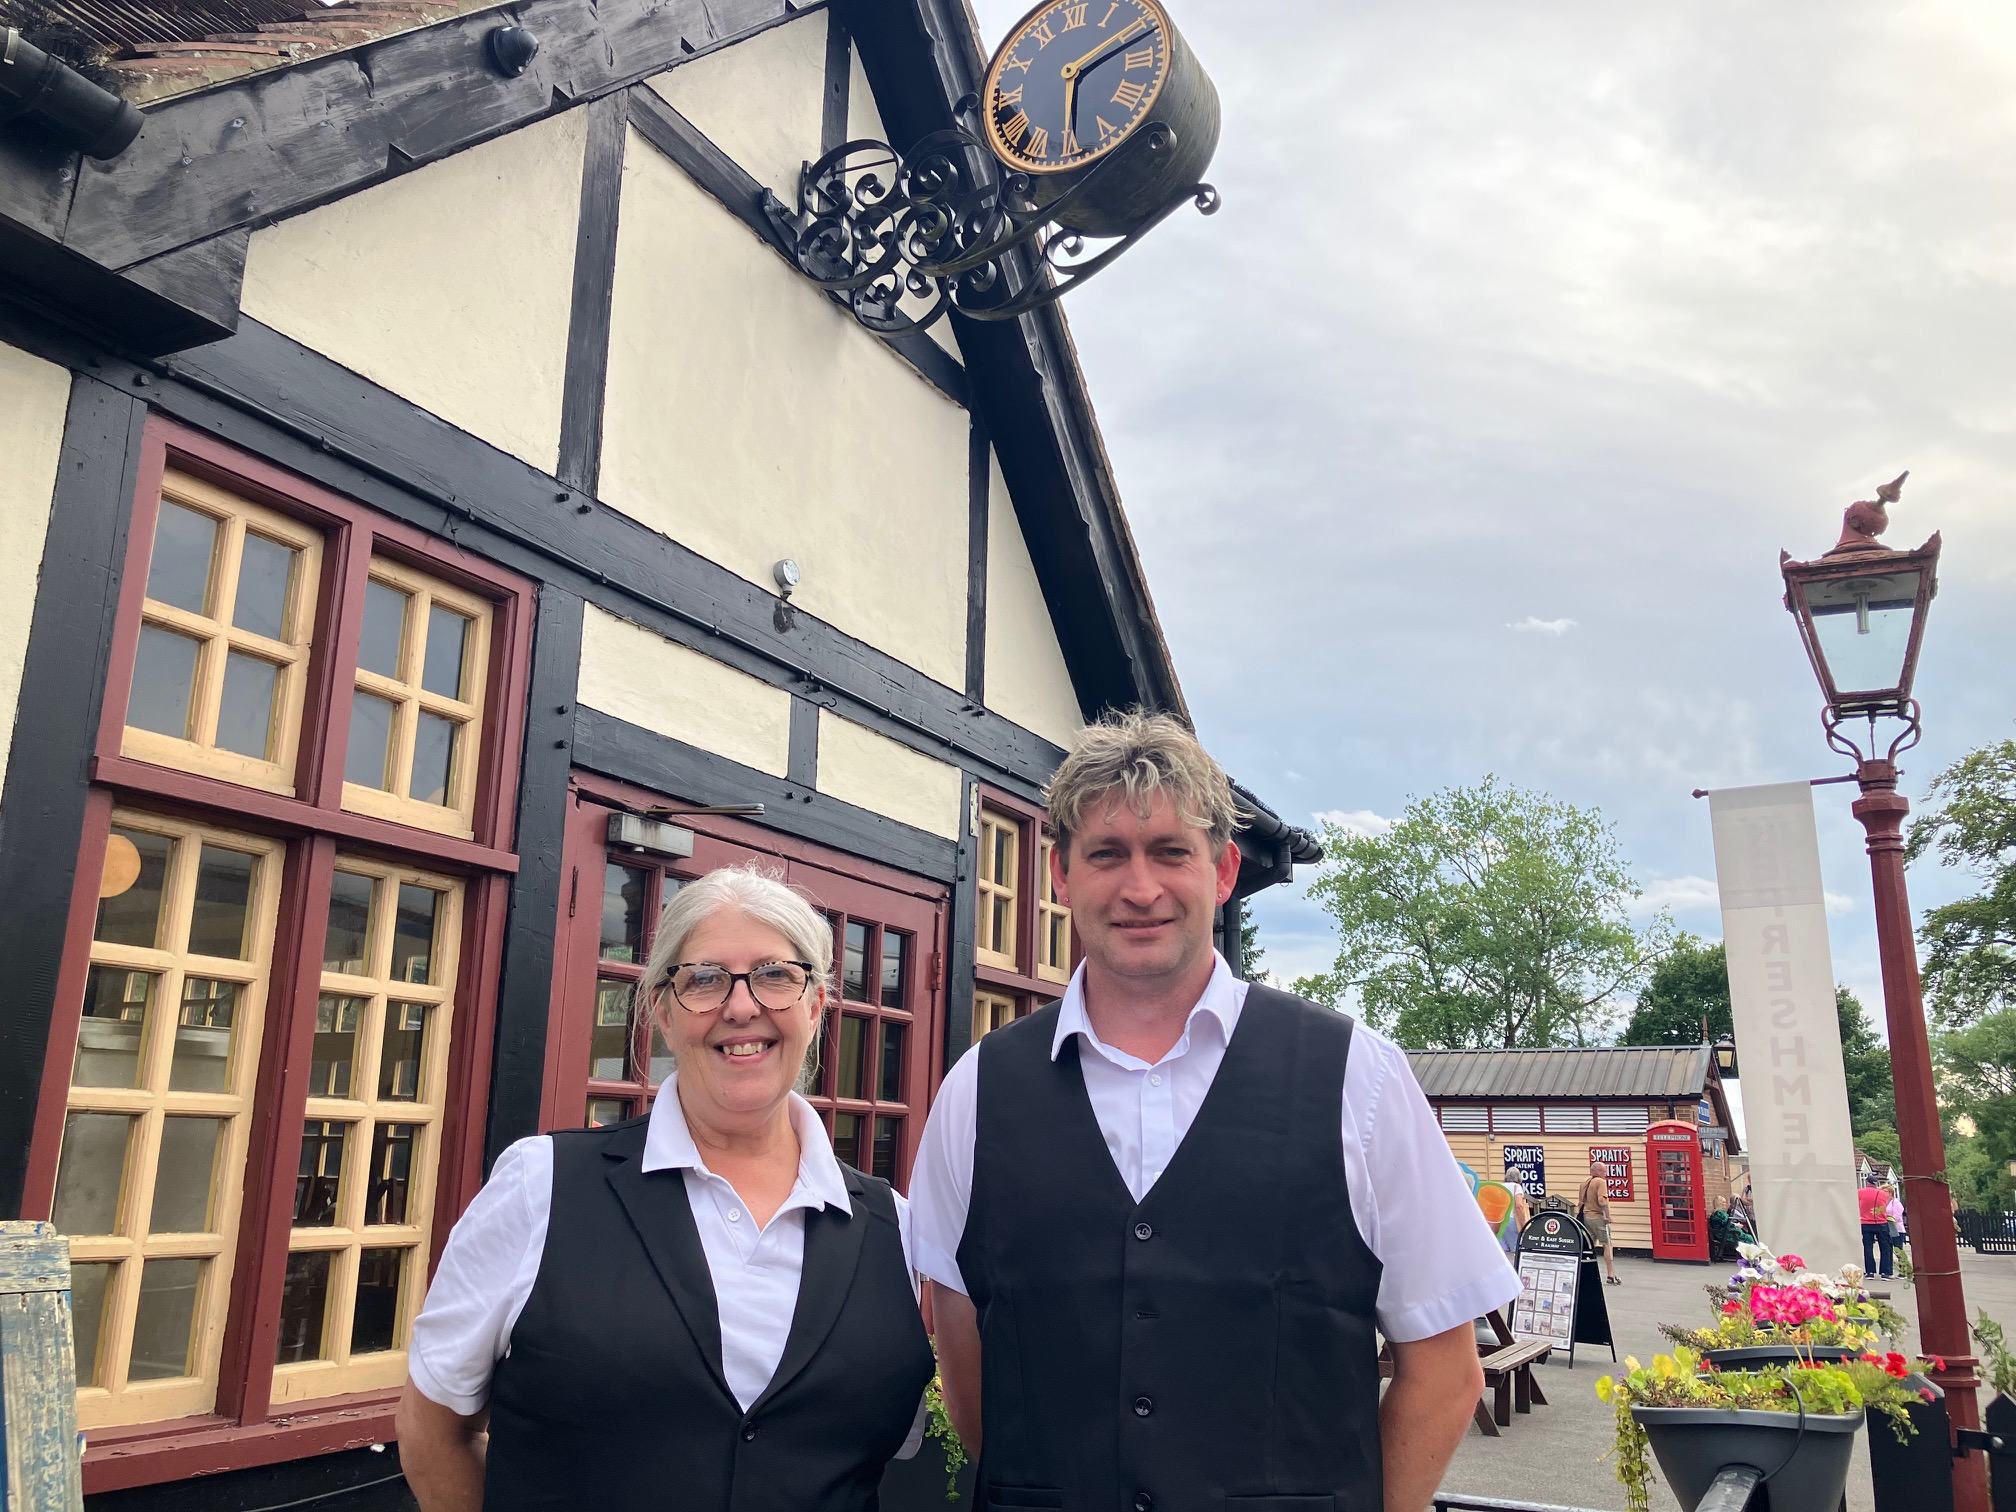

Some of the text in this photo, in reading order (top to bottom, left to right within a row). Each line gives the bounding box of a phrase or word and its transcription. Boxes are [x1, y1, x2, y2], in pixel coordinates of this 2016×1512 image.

[1062, 2, 1089, 33] XII
[1097, 2, 1120, 28] I
[1030, 21, 1056, 51] XI
[1007, 54, 1033, 74] X
[1124, 46, 1154, 71] III
[998, 83, 1024, 110] IX
[1110, 79, 1147, 111] IIII
[1002, 107, 1030, 147] VIII
[1096, 115, 1118, 141] V
[1023, 125, 1049, 159] VII
[1060, 129, 1082, 158] VI
[1504, 1147, 1543, 1162] SPRATT'S
[1590, 1149, 1630, 1162] SPRATT'S
[1520, 1170, 1538, 1181] OG
[1605, 1164, 1627, 1177] TENT
[1522, 1183, 1545, 1195] KES
[1608, 1189, 1630, 1197] KES
